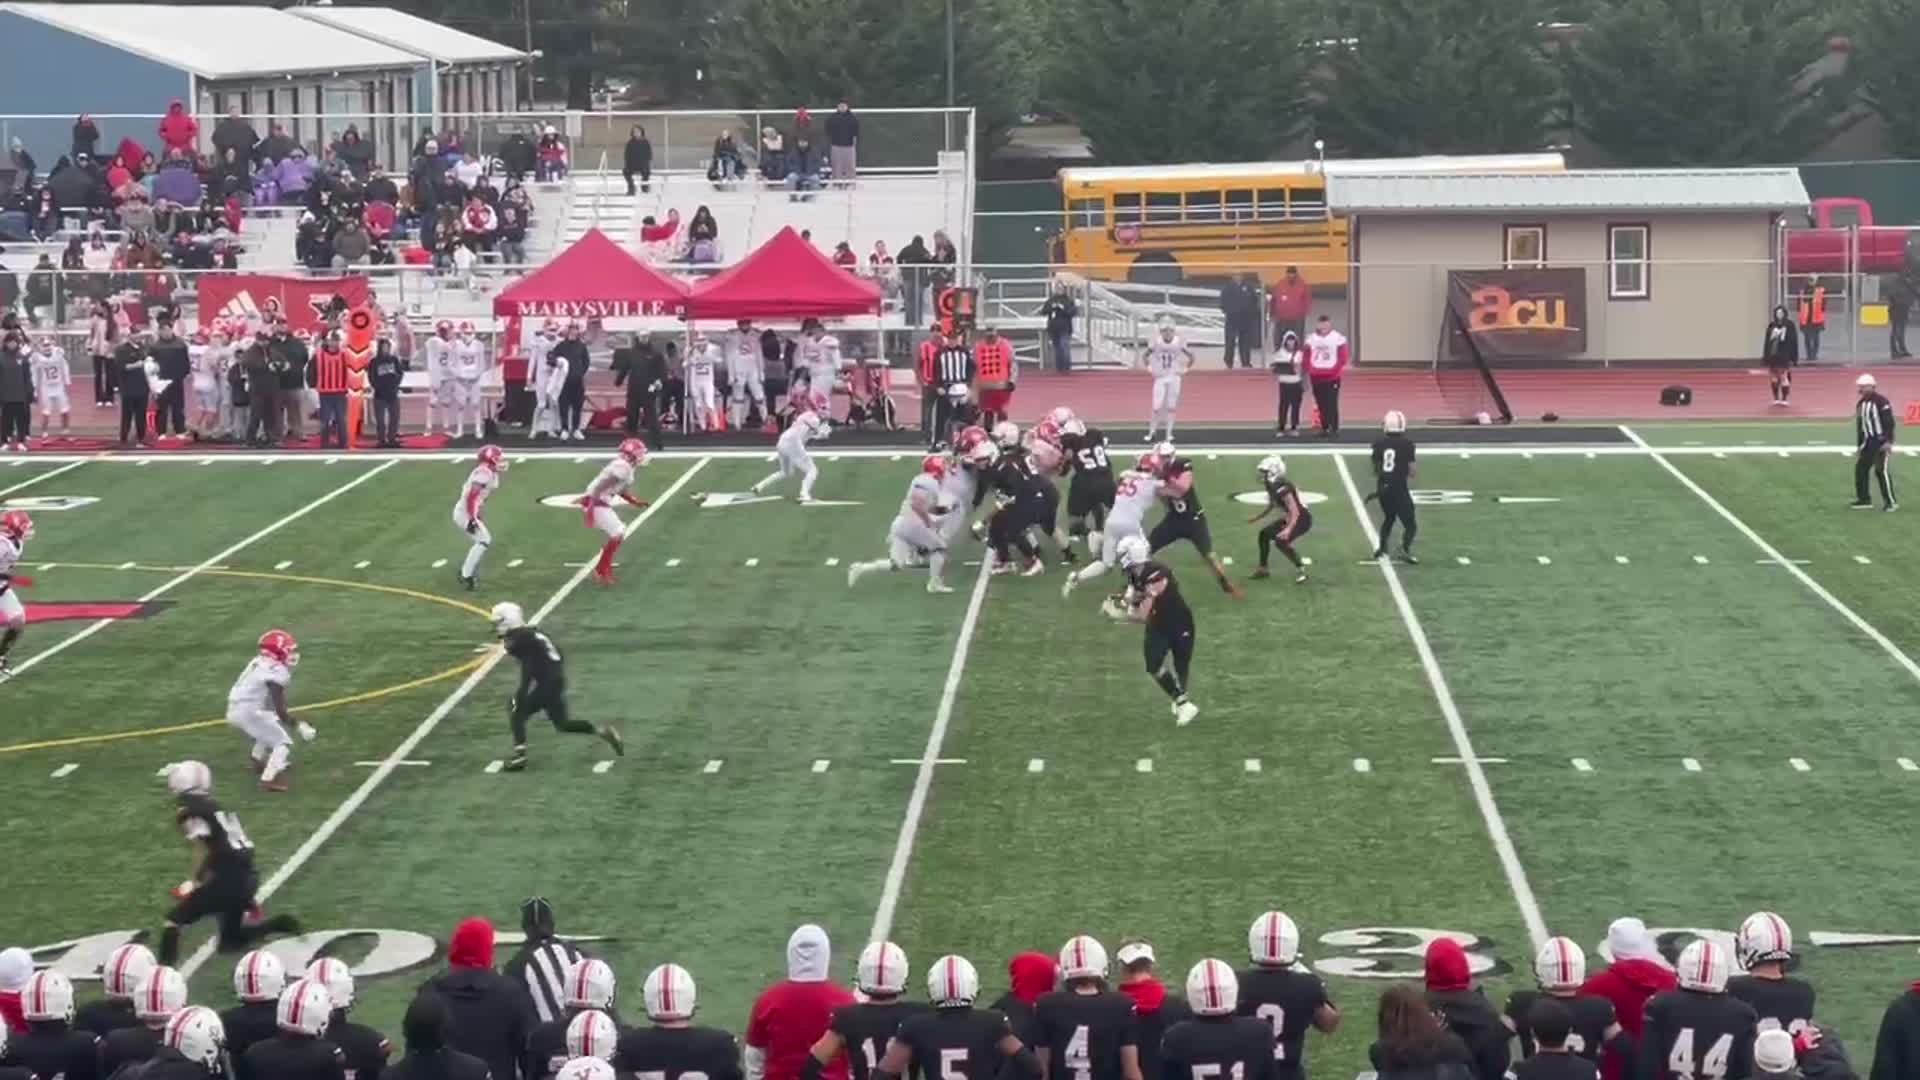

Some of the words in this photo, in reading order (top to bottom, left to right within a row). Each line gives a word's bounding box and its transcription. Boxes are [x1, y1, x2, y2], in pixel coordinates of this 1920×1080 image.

[517, 301, 664, 315] MARYSVILLE
[1077, 445, 1108, 469] 58
[1382, 449, 1396, 472] 8
[1064, 1025, 1091, 1080] 4
[1668, 1028, 1735, 1080] 44
